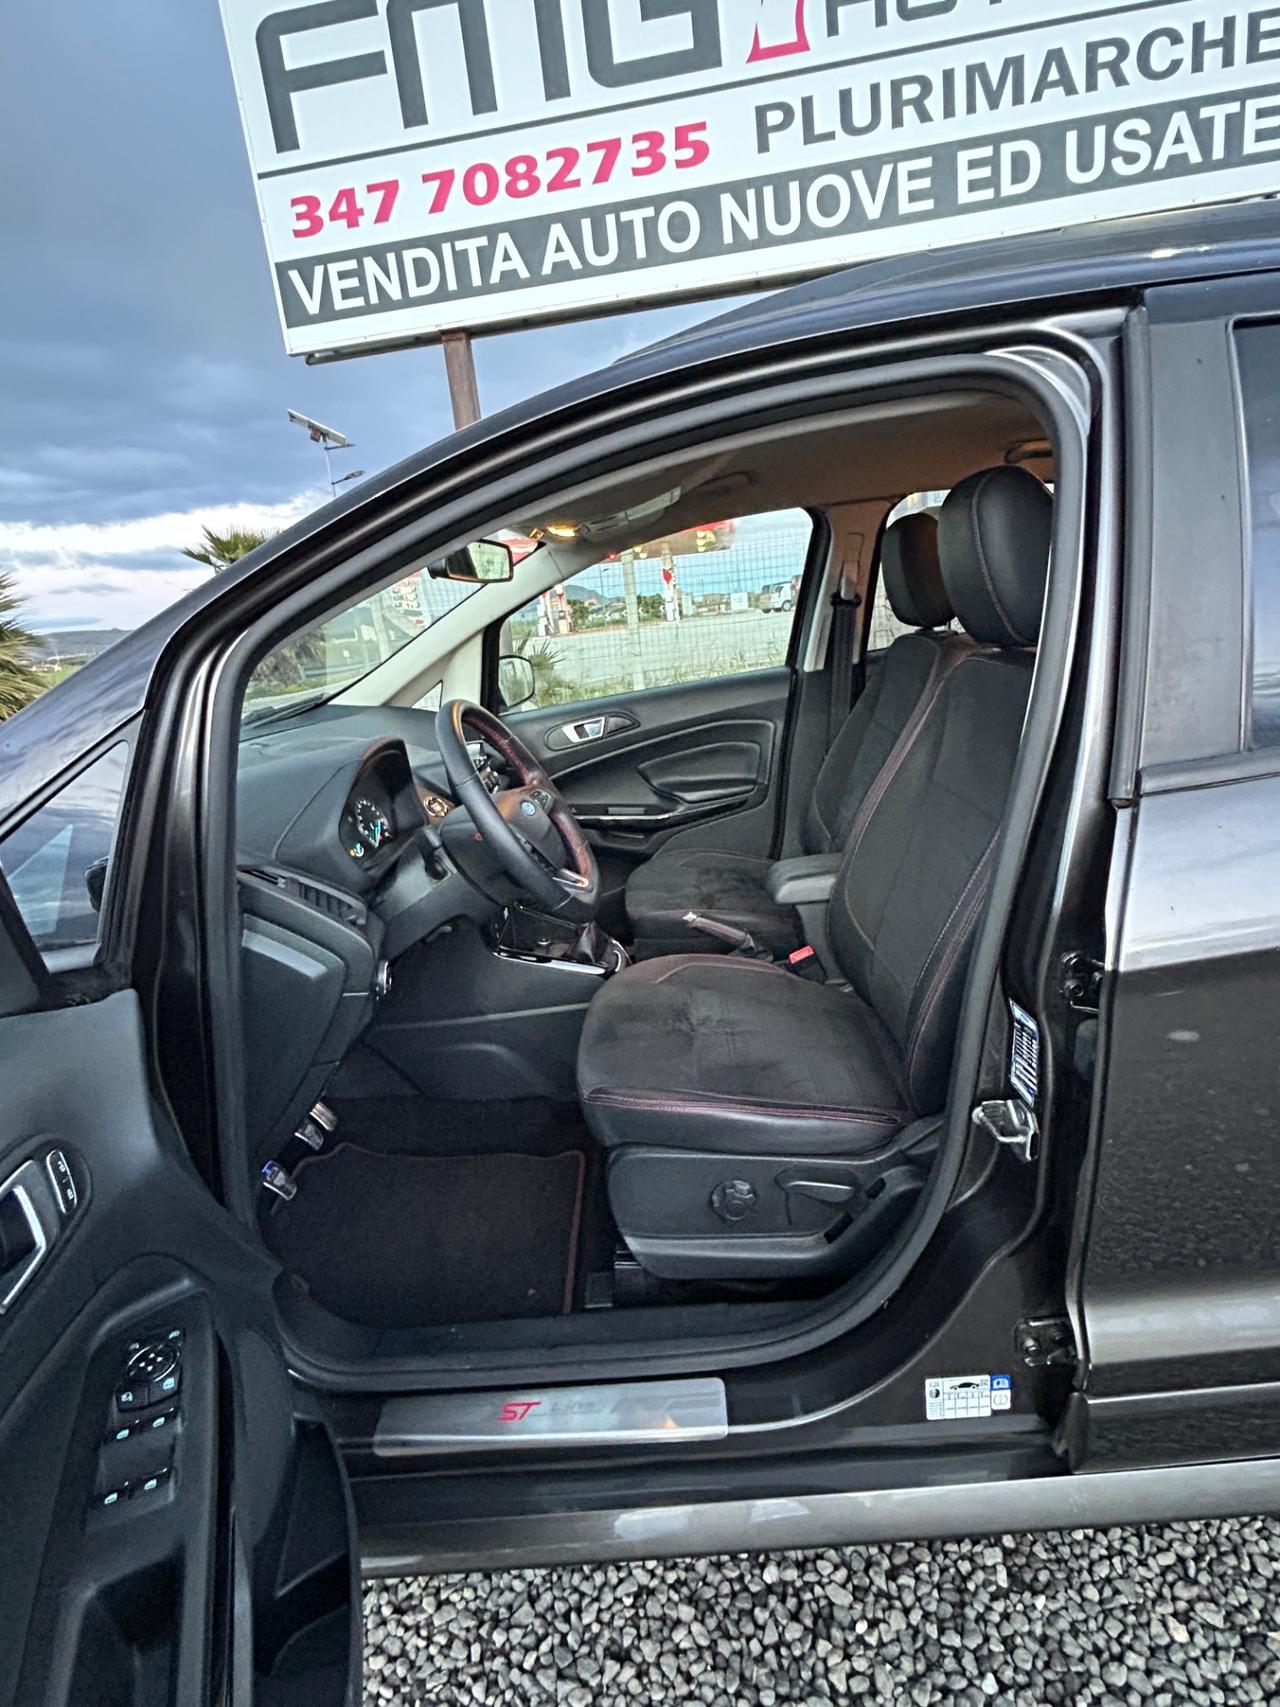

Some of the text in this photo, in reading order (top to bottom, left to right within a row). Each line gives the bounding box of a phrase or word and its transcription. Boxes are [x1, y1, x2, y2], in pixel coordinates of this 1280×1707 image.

[755, 8, 1280, 153] PLURIMARCHE
[288, 95, 1280, 314] VENDITA AUTO NUOVE ED USATE
[292, 122, 709, 237] 347 7082735
[496, 1401, 540, 1423] ST
